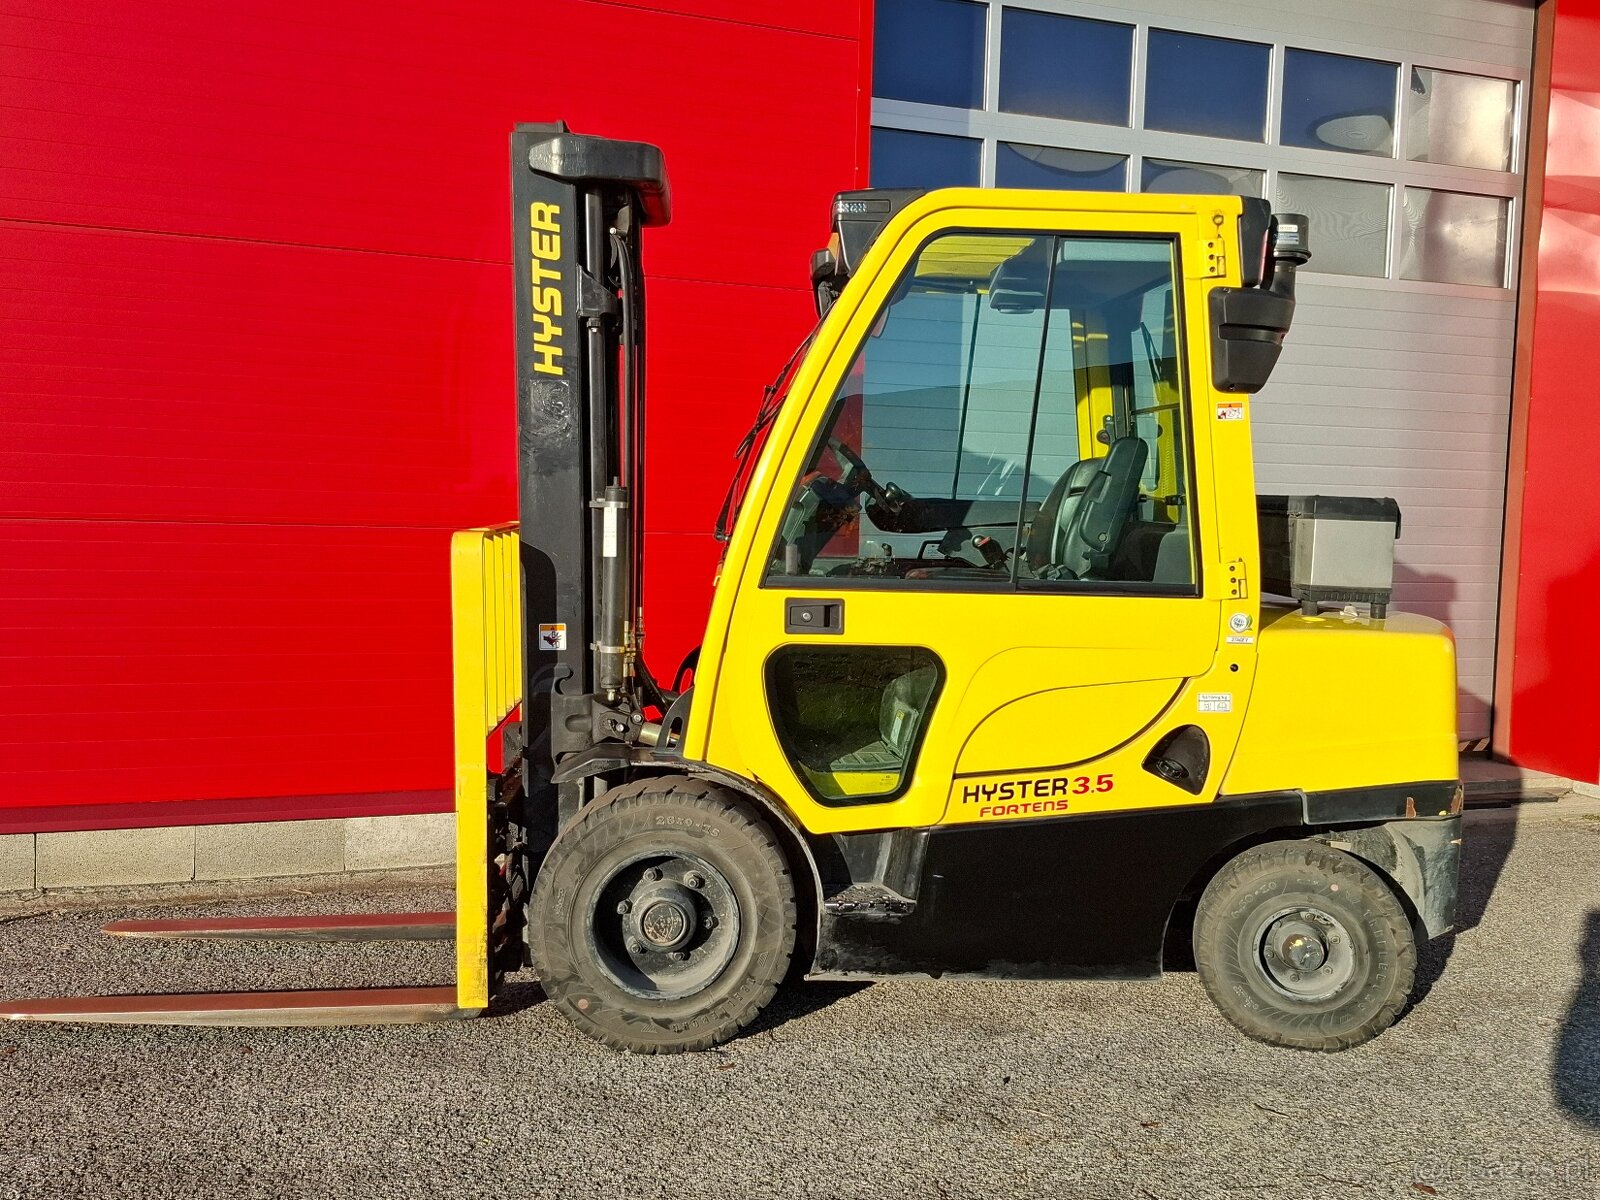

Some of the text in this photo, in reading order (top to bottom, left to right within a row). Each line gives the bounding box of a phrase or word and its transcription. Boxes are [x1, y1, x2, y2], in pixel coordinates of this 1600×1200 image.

[530, 201, 563, 376] HYSTER
[963, 774, 1114, 804] HYSTER 3.5
[979, 800, 1069, 817] FORTENS
